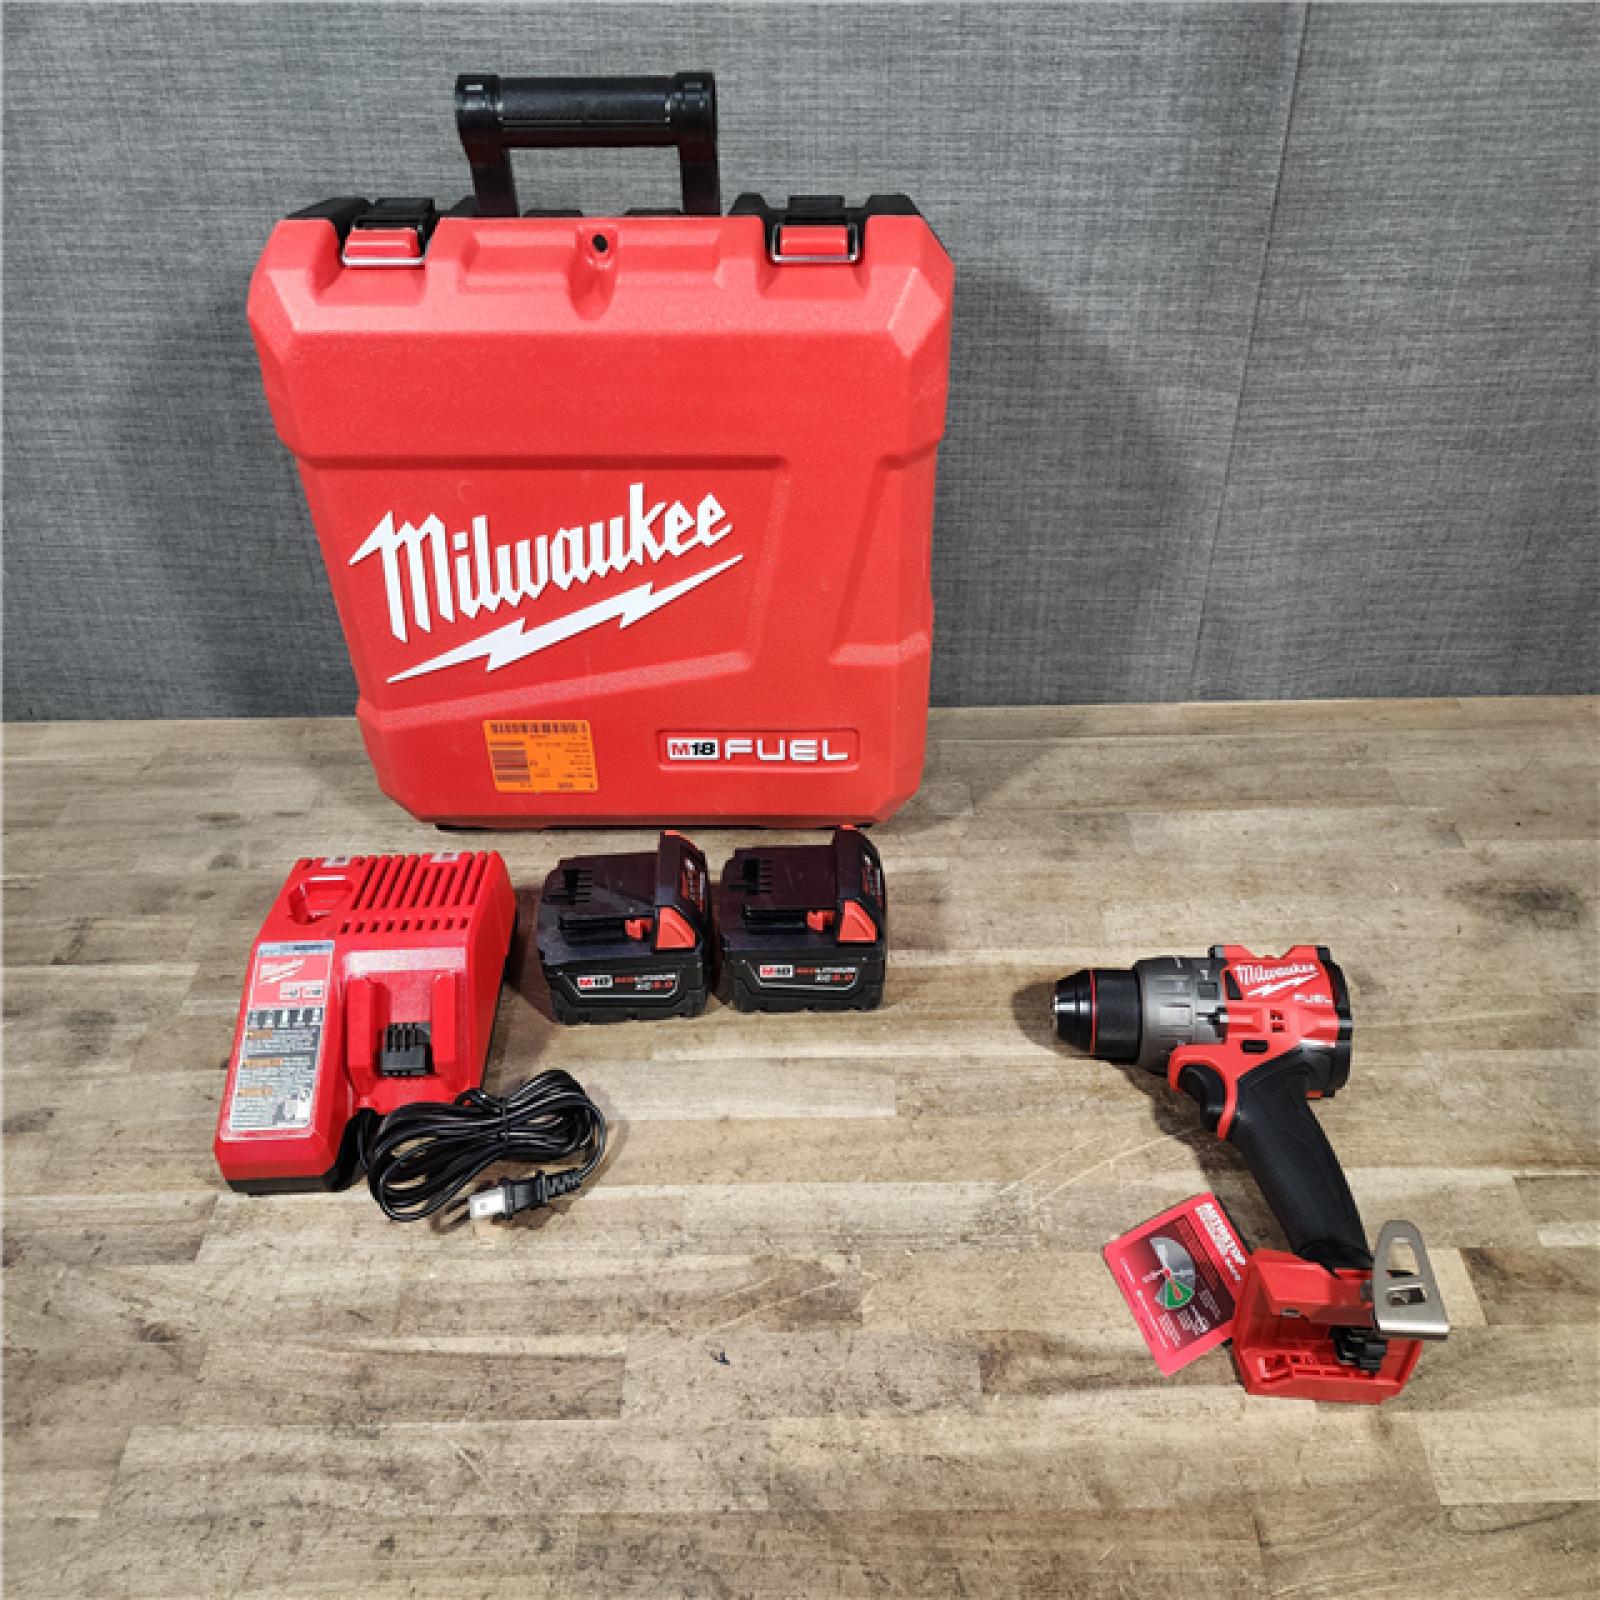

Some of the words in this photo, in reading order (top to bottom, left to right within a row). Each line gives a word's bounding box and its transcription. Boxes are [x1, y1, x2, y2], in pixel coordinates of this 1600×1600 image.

[348, 483, 733, 641] Milwaukee
[668, 737, 718, 760] M18
[724, 739, 848, 762] FUEL
[1234, 962, 1316, 986] Milwaukee
